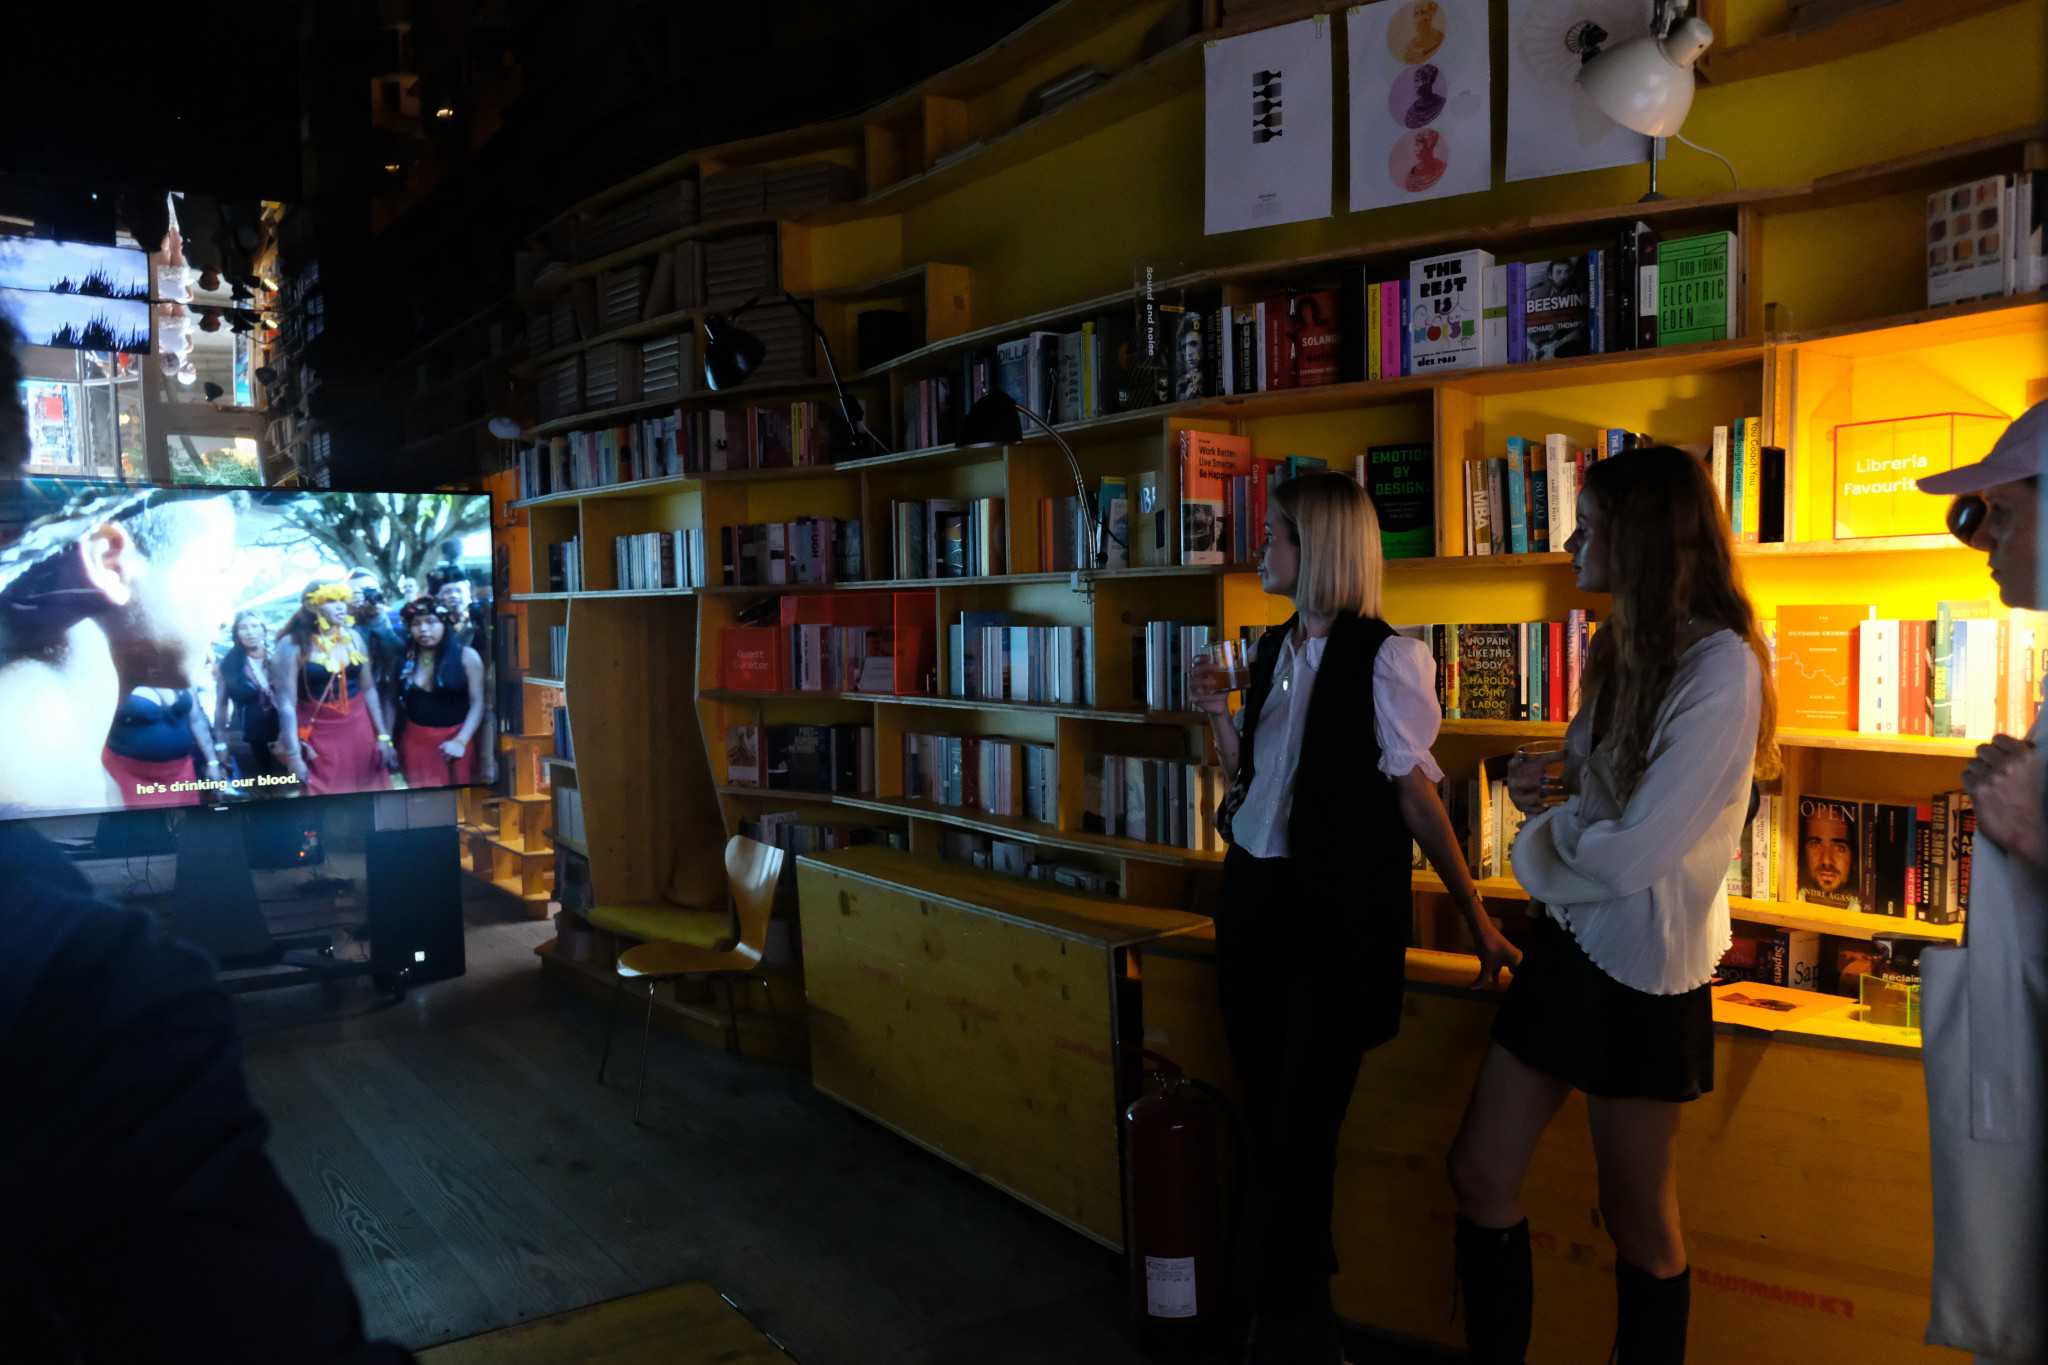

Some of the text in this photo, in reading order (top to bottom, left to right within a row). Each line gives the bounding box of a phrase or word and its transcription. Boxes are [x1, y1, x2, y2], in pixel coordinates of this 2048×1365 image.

[1424, 259, 1461, 279] THE
[1420, 277, 1467, 298] REST
[1663, 279, 1724, 307] ELECTRIC
[1145, 265, 1154, 357] Sound and noise
[1434, 297, 1452, 314] IS
[1526, 294, 1584, 313] BEESWIN
[1662, 307, 1693, 330] EDEN
[1418, 355, 1457, 366] alex ross
[1200, 446, 1216, 455] Work
[1748, 422, 1759, 486] You Coach You
[1393, 464, 1410, 479] BY
[1856, 453, 1928, 473] Libreria
[1843, 477, 1919, 496] Favourit
[1473, 490, 1489, 529] MBA
[1471, 636, 1509, 646] NO PAIN
[1467, 648, 1512, 658] LIKE THIS
[1475, 661, 1503, 670] BODY
[1470, 676, 1510, 686] HAROLD
[1472, 688, 1506, 697] SONNY
[136, 773, 300, 795] he's drinking our blood.
[1800, 800, 1857, 823] OPEN
[1794, 961, 1819, 988] Sap
